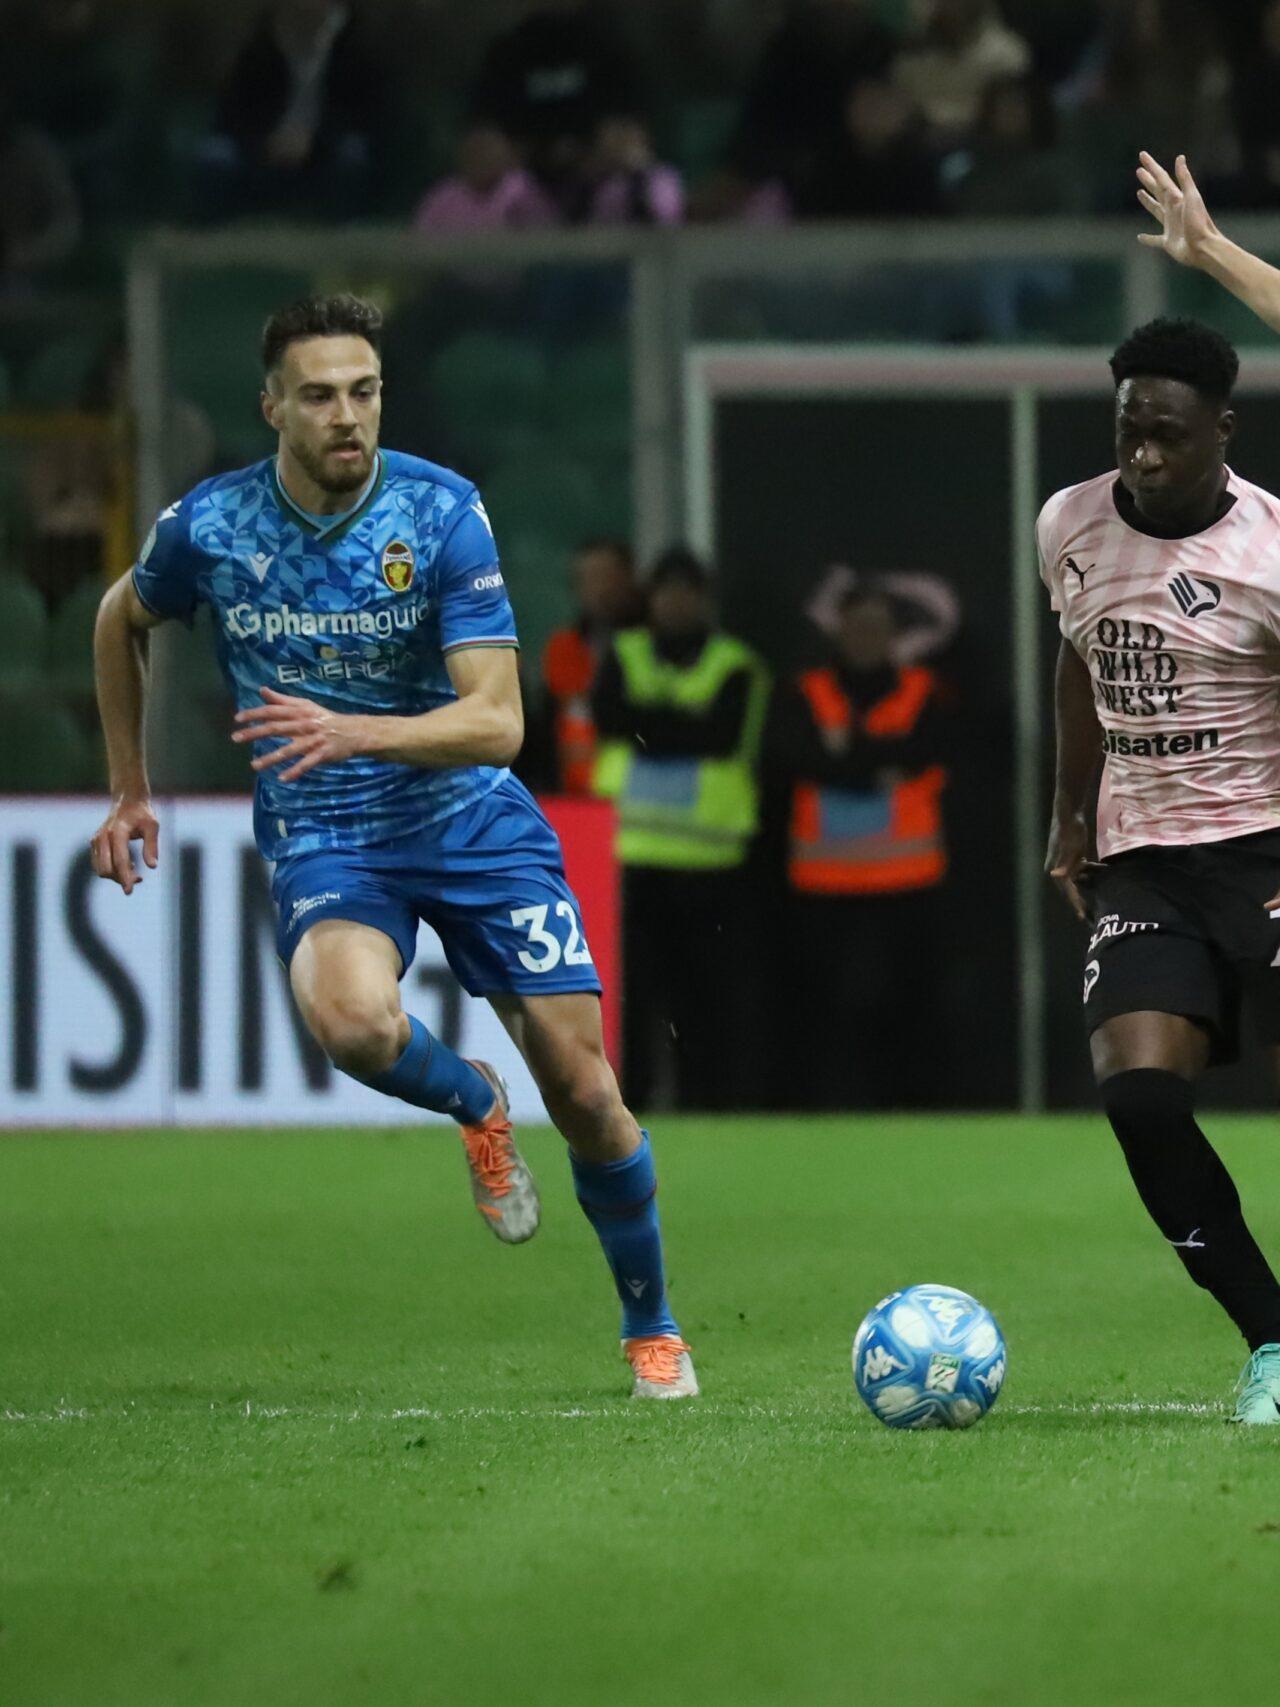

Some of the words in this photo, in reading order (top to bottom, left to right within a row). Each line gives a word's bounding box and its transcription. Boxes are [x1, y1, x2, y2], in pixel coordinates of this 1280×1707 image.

[1097, 617, 1165, 650] OLD
[1093, 649, 1179, 683] WILD
[1097, 682, 1184, 717] WEST
[511, 900, 593, 973] 32
